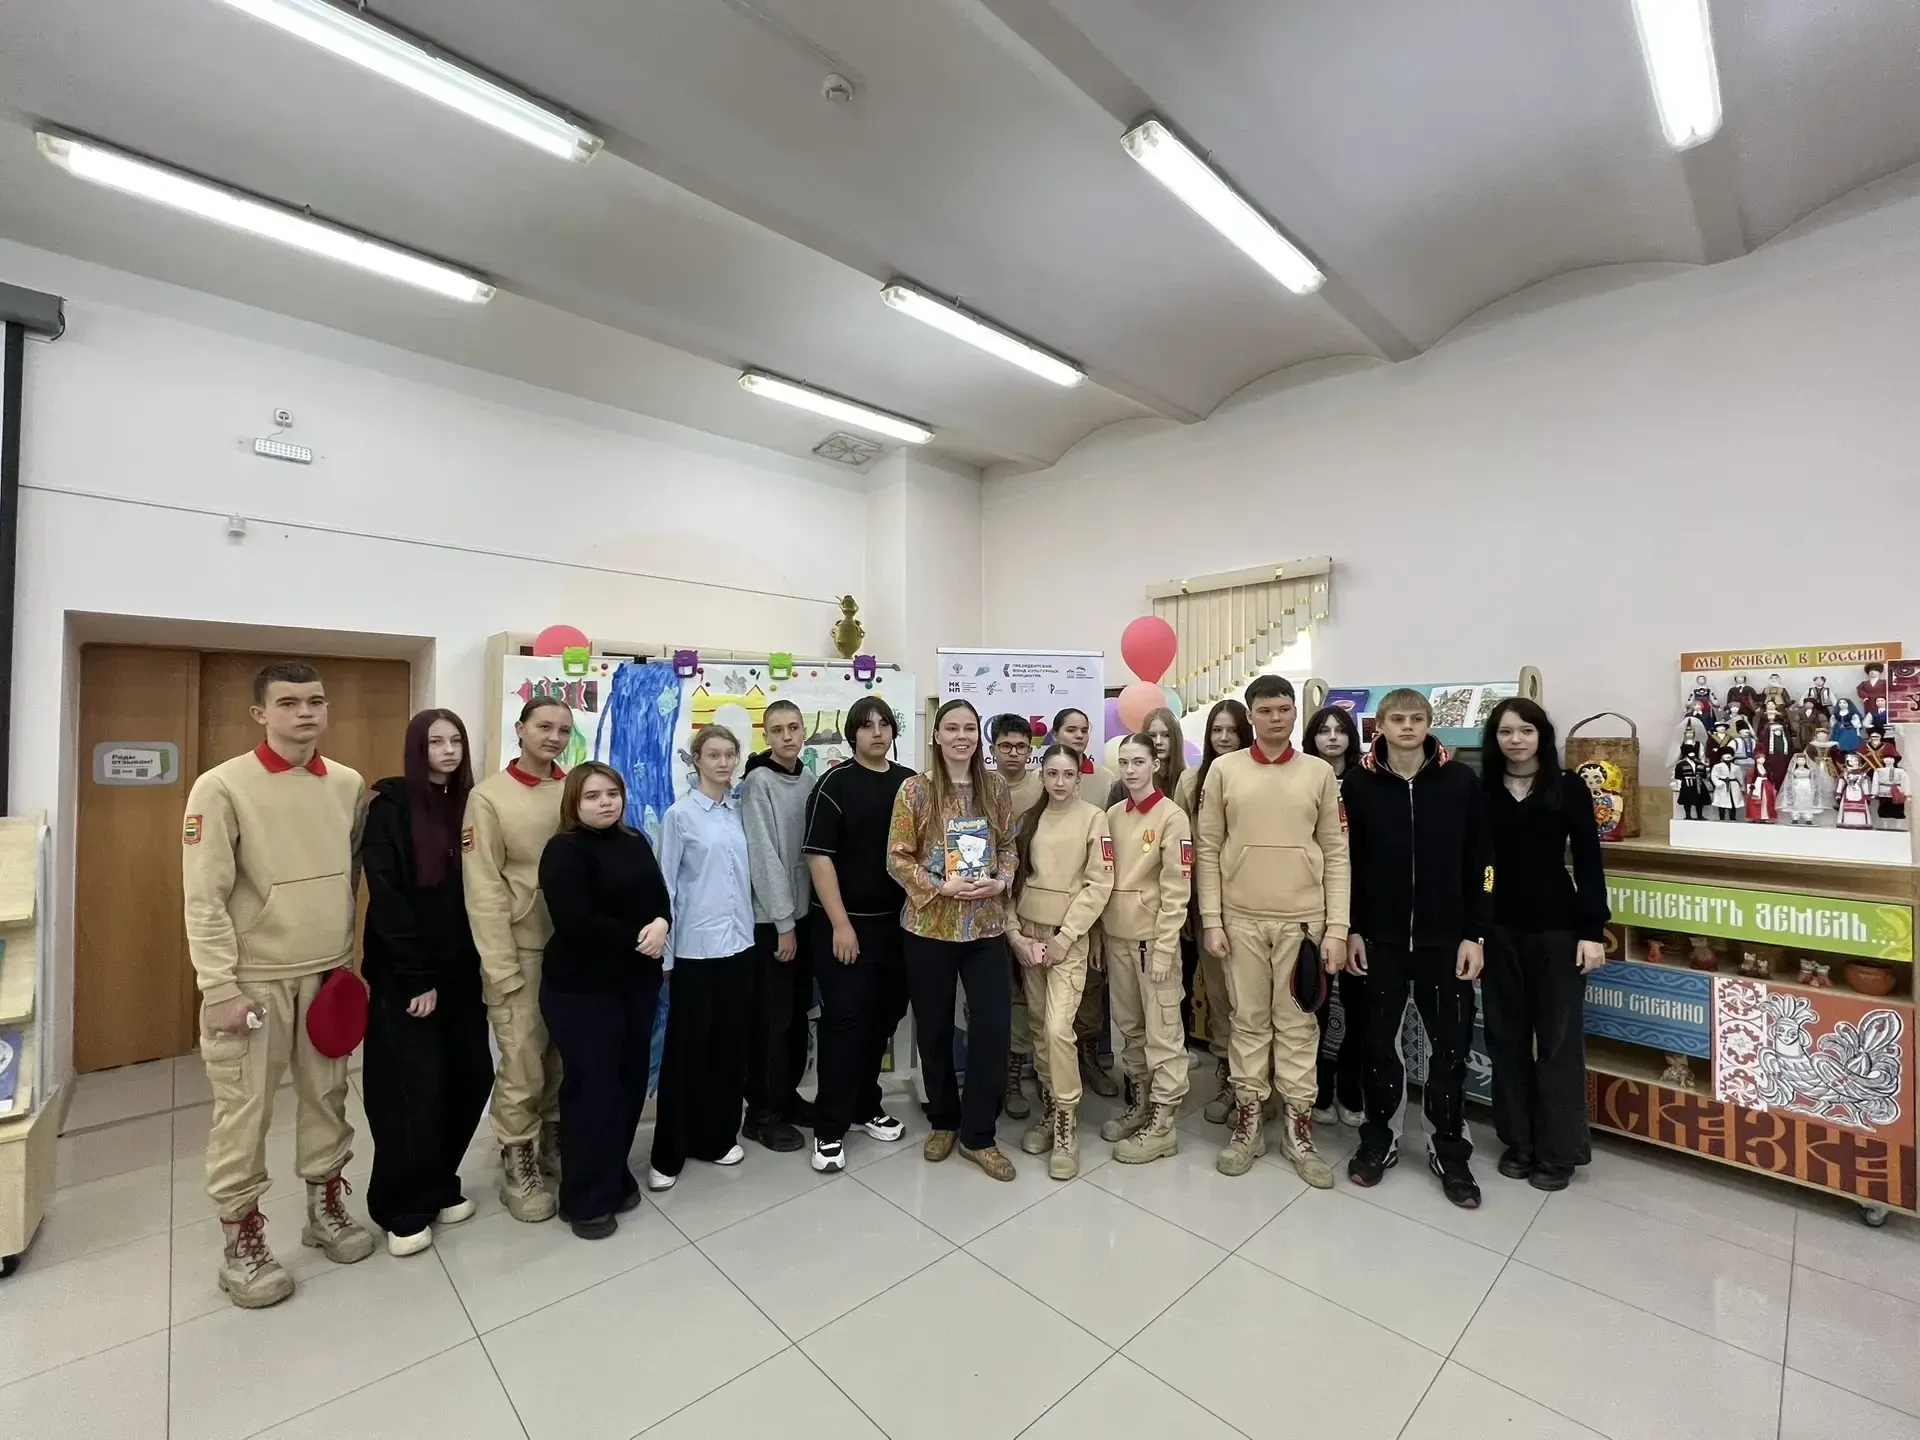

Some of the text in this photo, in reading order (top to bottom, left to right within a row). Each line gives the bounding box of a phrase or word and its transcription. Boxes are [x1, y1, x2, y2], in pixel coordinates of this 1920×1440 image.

[1695, 649, 1884, 668] МЫ ЖИВЁМ В РОССИИ!
